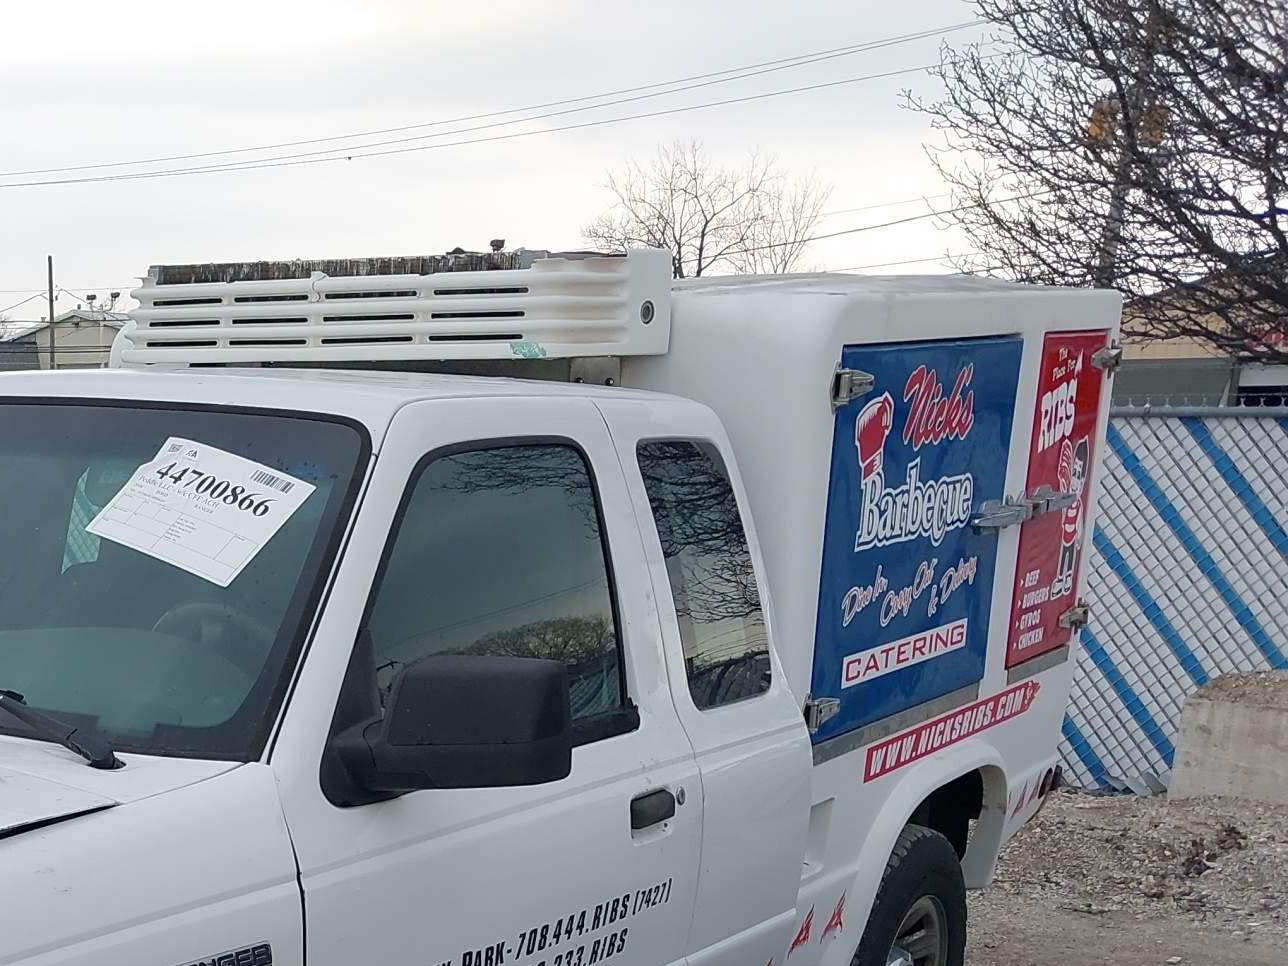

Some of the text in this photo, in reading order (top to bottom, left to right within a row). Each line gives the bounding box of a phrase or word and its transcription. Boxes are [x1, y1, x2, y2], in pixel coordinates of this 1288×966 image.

[1052, 359, 1077, 381] Place For
[1059, 347, 1068, 361] The
[903, 363, 974, 451] Nick's
[1038, 378, 1078, 454] RIBS
[155, 462, 277, 517] 44700866
[855, 457, 974, 552] Barbecue
[880, 558, 938, 627] Carry Out
[927, 556, 977, 617] & Delivery
[1022, 586, 1049, 609] BURGERS
[1025, 569, 1040, 588] BEEF
[842, 585, 873, 627] Dine
[1020, 608, 1041, 630] GYROS
[845, 623, 965, 682] CATERING
[1018, 626, 1044, 650] CHICKEN
[869, 687, 1025, 777] WWW.NICKSRIBS.COM
[632, 877, 673, 916] (7427)
